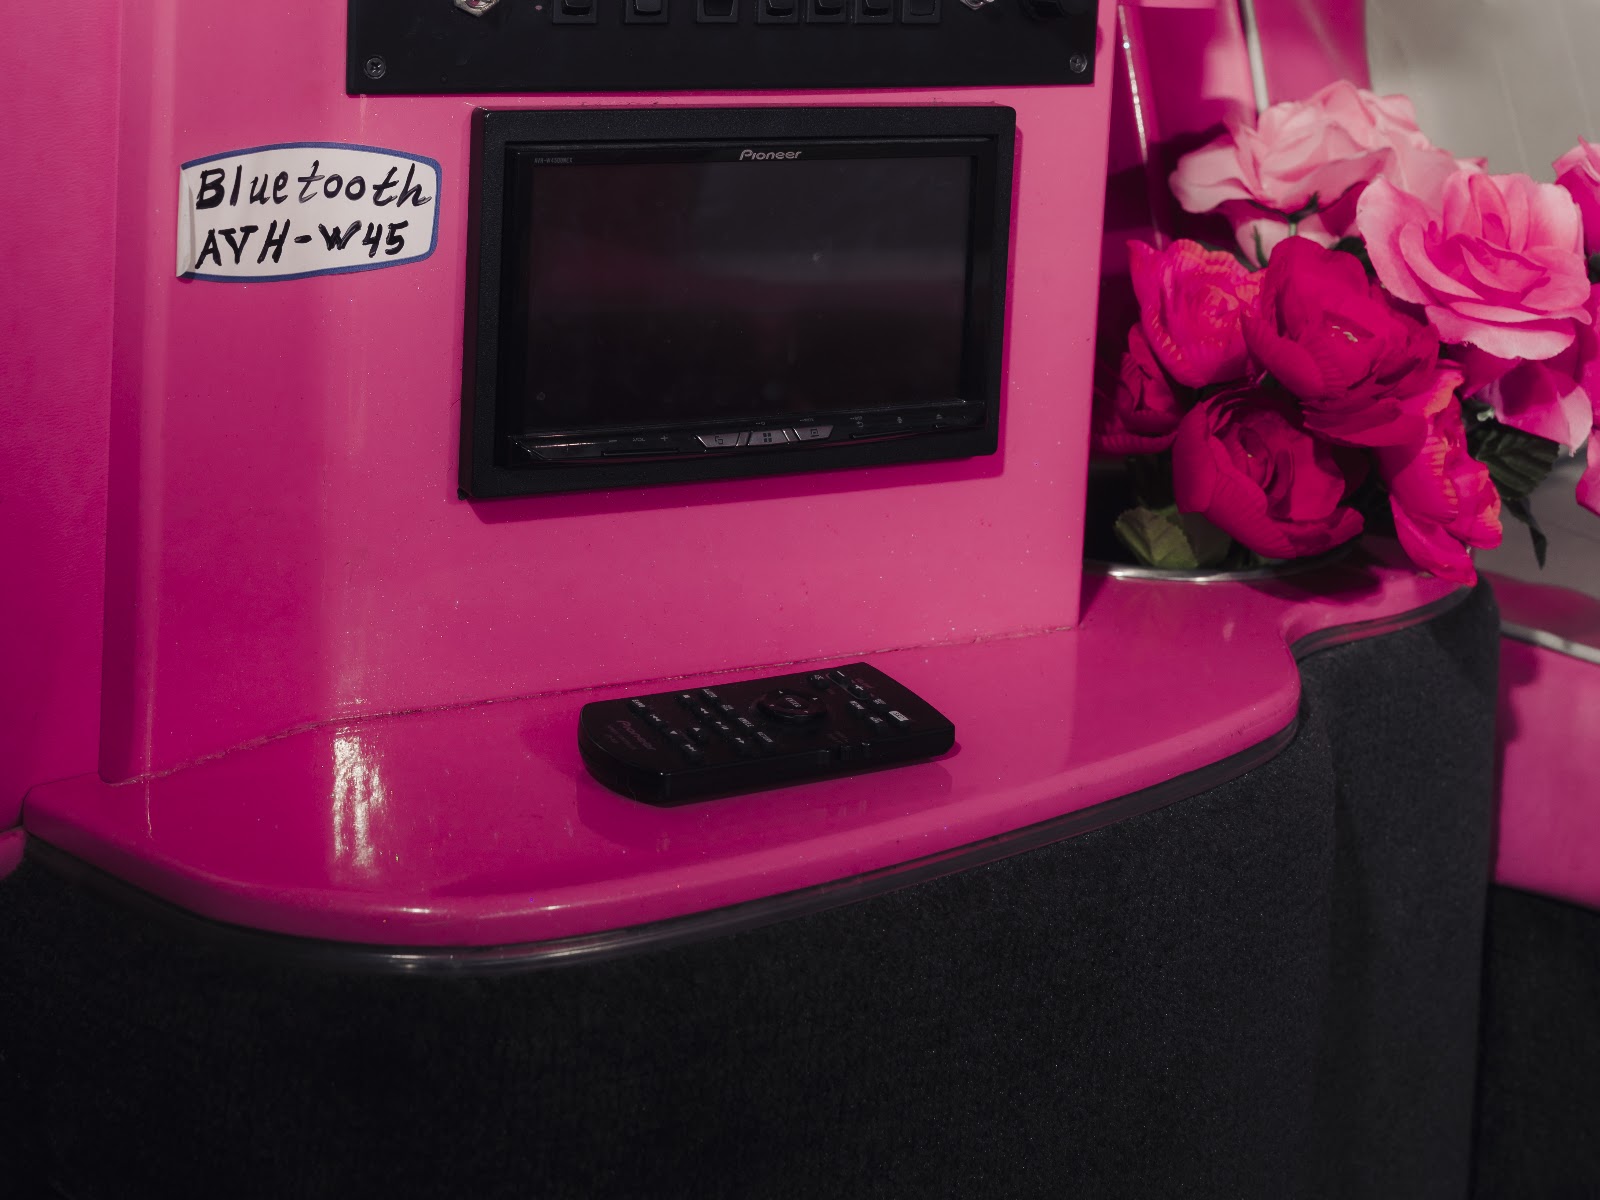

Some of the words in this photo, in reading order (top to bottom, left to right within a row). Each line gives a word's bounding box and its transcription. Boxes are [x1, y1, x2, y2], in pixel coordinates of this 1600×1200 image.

[739, 149, 802, 161] Pioneer
[195, 159, 433, 210] Bluetooth
[194, 218, 409, 270] AVH-W45
